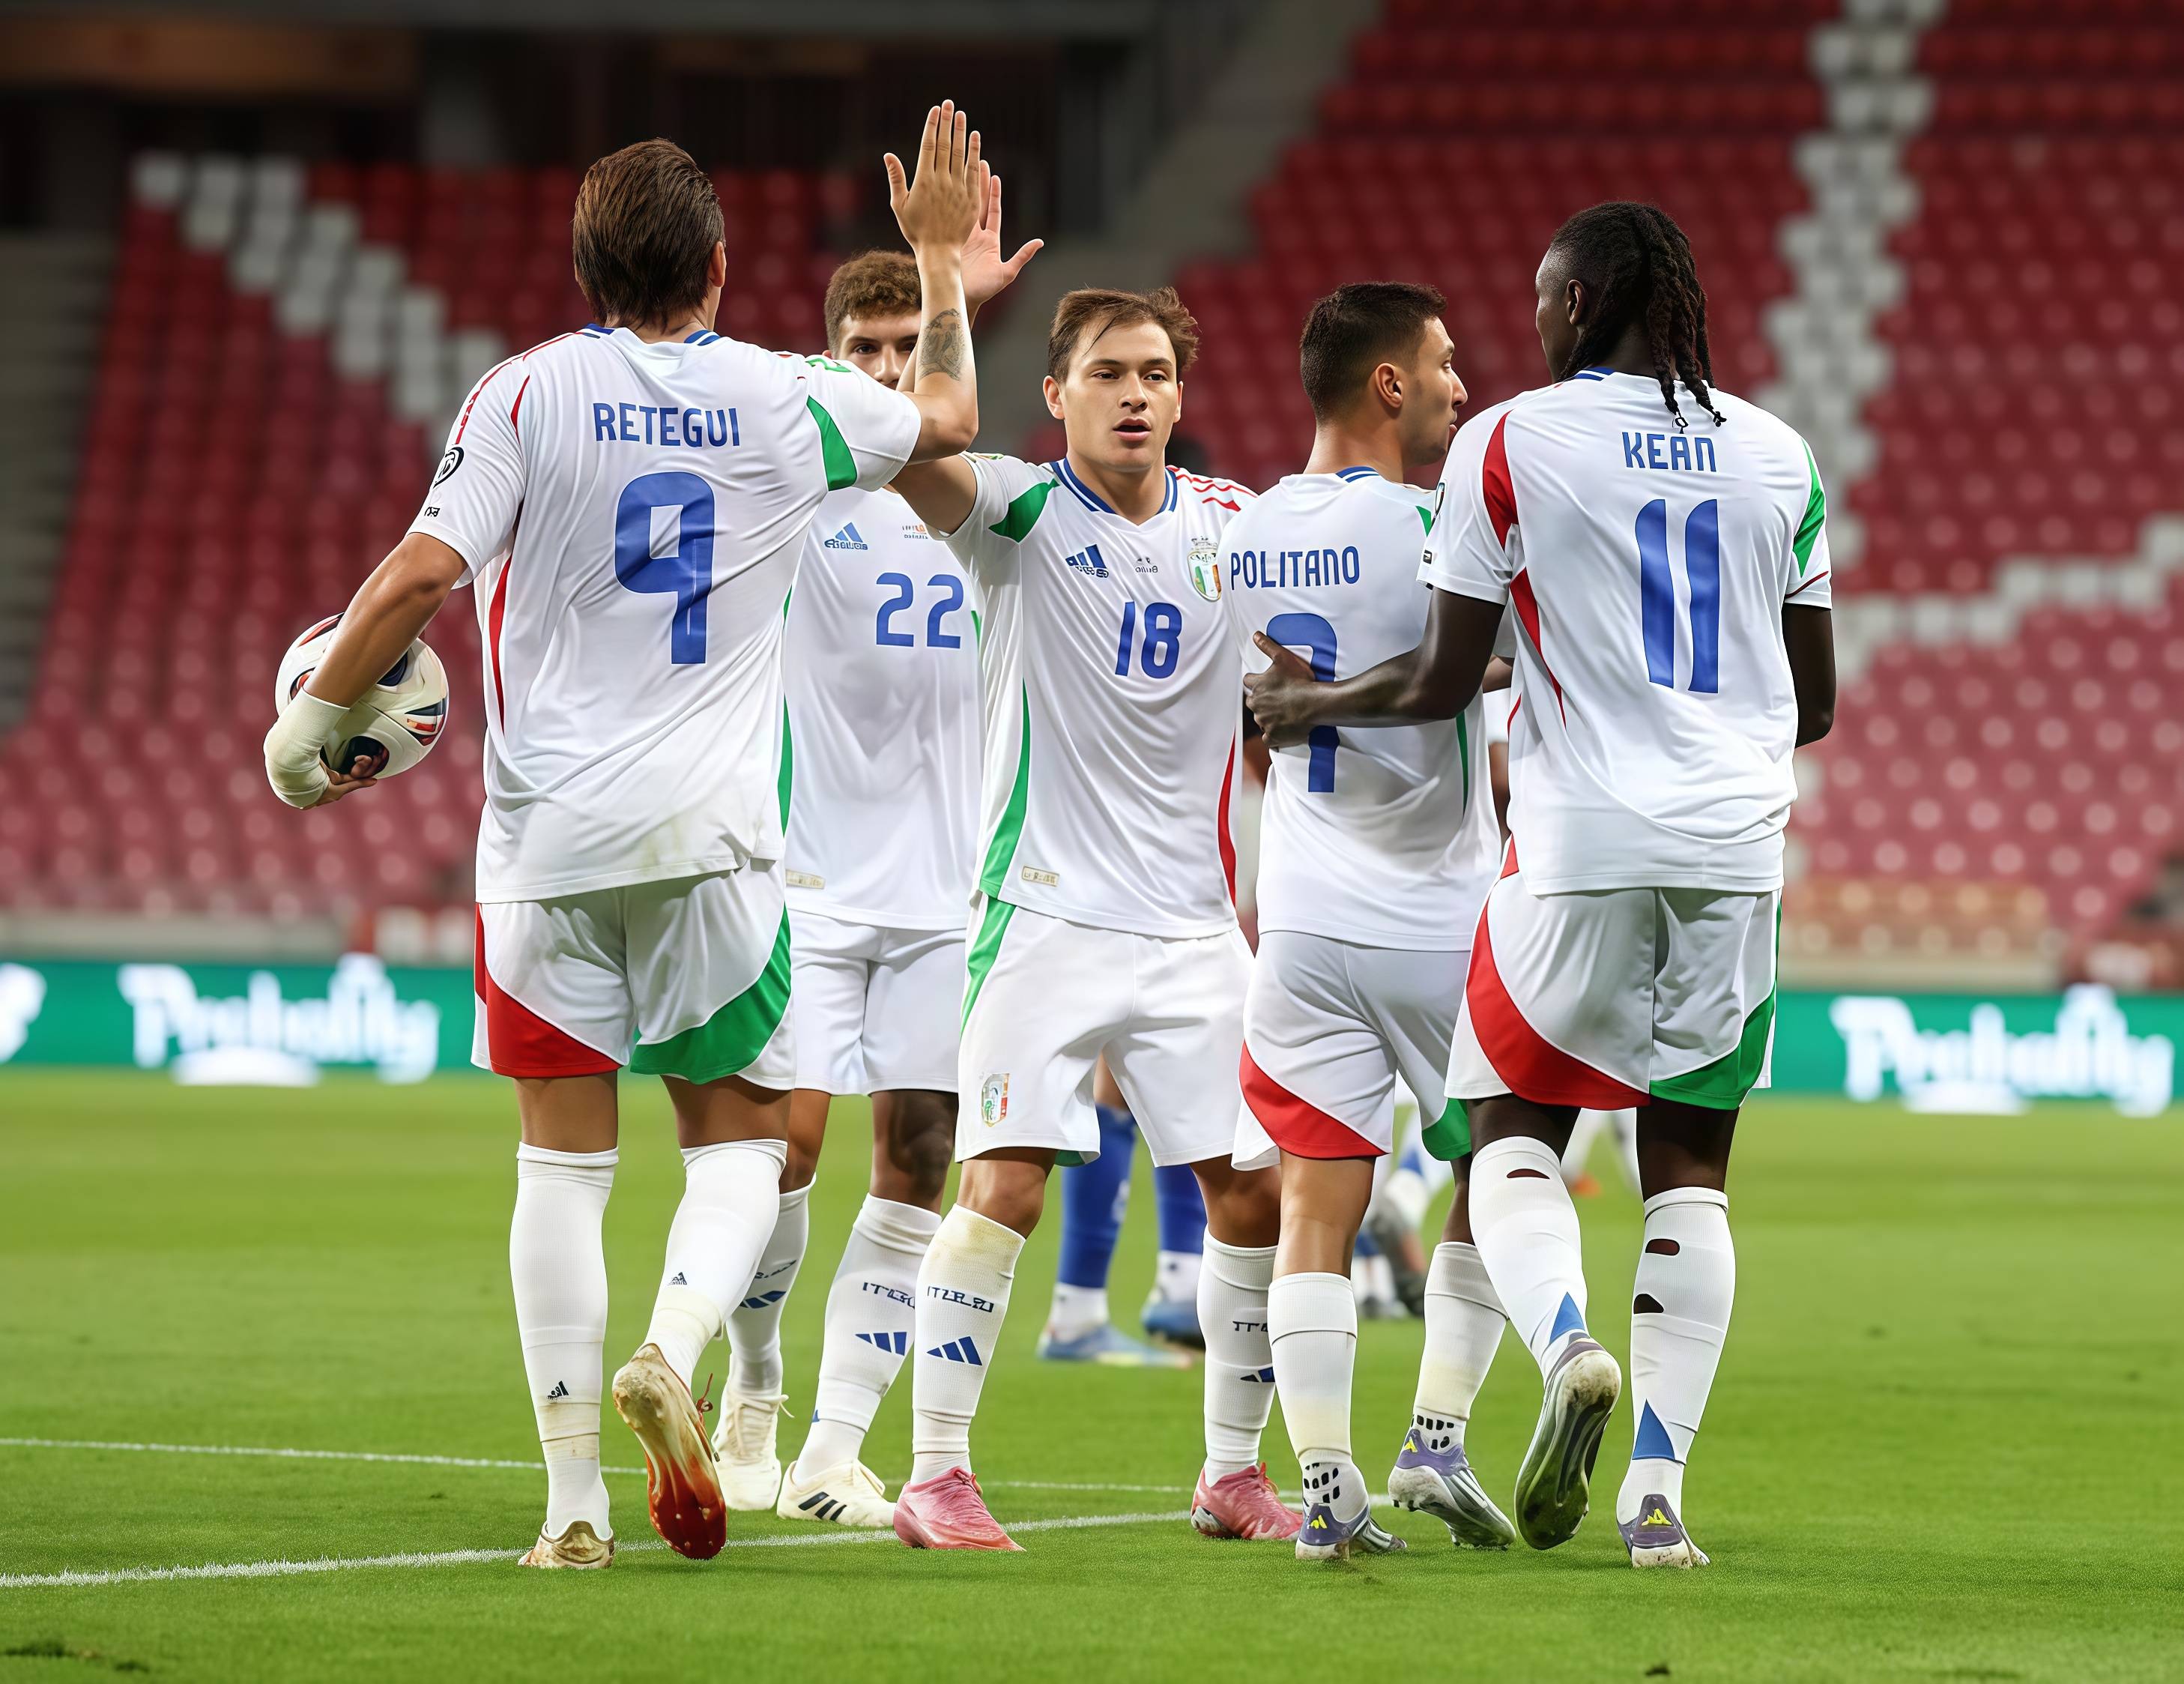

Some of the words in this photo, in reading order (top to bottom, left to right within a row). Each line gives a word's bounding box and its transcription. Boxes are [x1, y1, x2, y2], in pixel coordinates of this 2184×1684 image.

[593, 402, 740, 448] RETEGUI
[1622, 431, 1717, 472] KEAN
[614, 471, 716, 665] 9
[1230, 545, 1361, 590] POLITANO
[1634, 498, 1721, 695] 11
[875, 572, 964, 650] 22
[1115, 600, 1183, 679] 18
